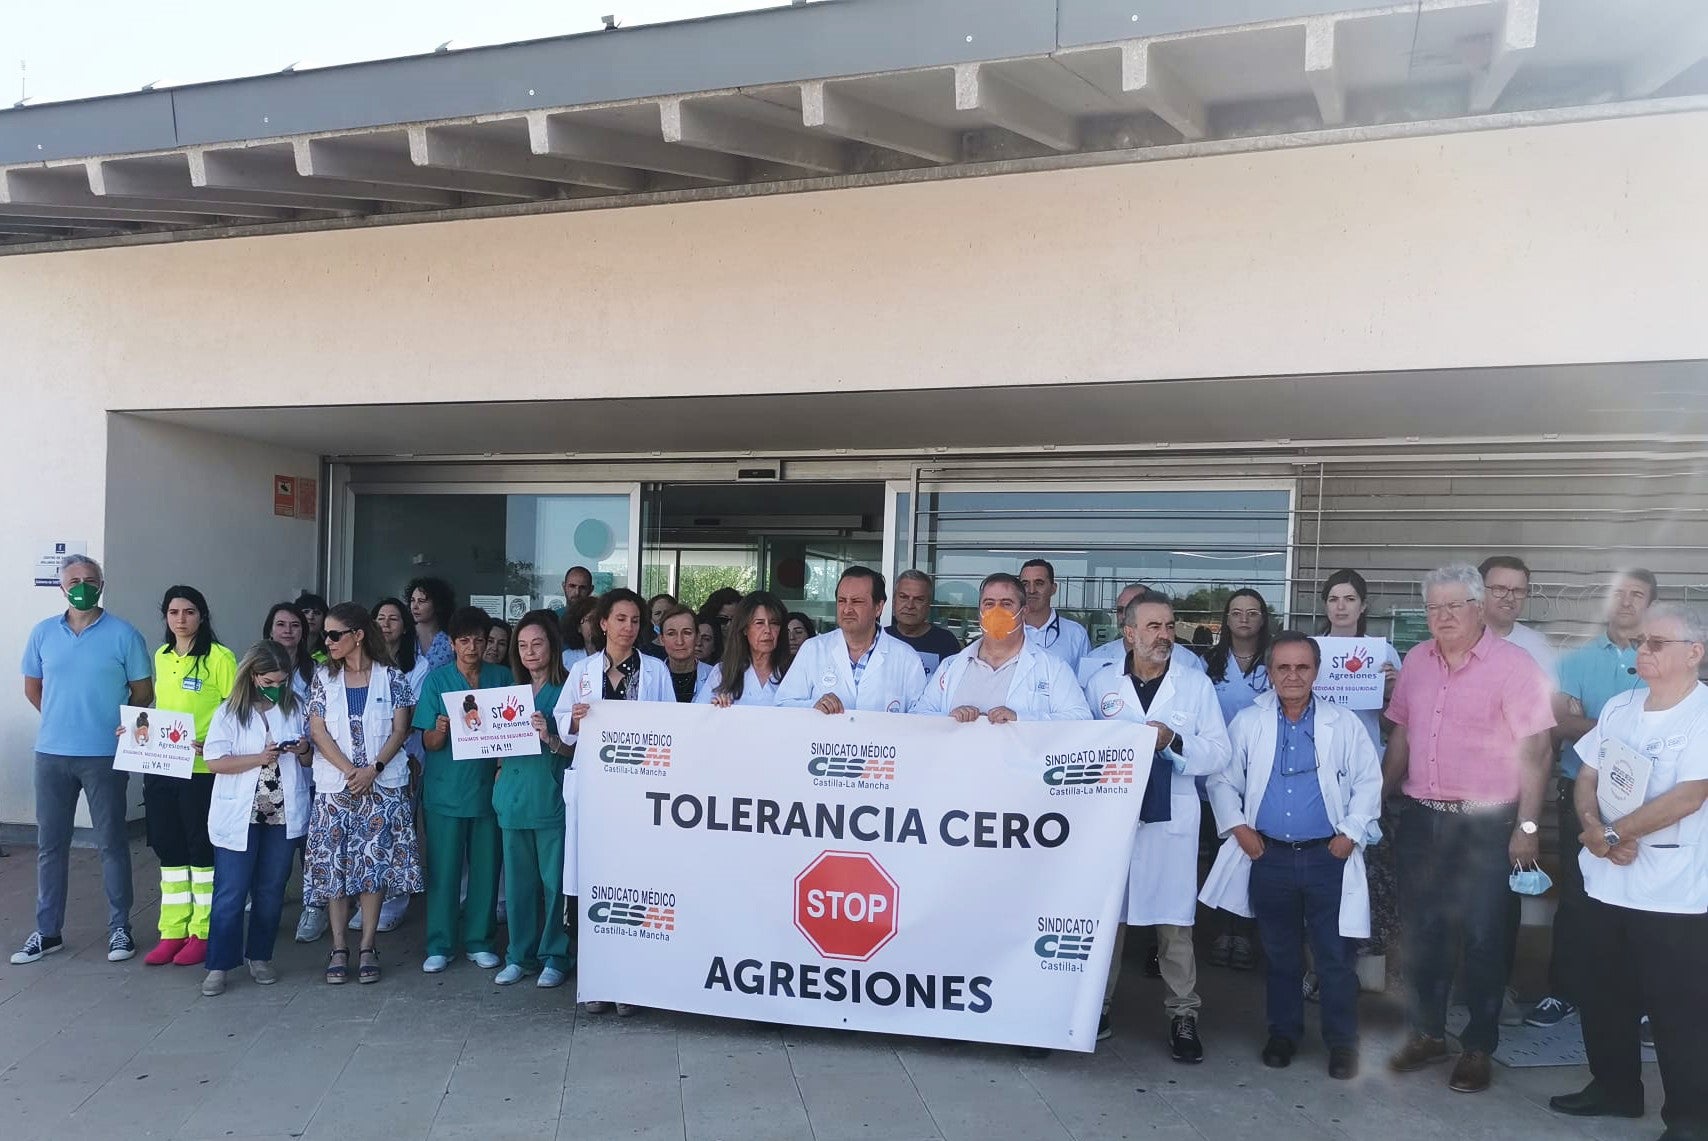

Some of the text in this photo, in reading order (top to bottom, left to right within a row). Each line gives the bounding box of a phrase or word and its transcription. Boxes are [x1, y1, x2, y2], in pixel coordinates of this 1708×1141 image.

[1329, 672, 1377, 680] Agresiones
[492, 720, 530, 730] Agresiones
[159, 742, 191, 751] Agresiones
[601, 730, 672, 747] SINDICATO MÉDICO
[490, 744, 502, 752] YA
[599, 744, 671, 768] CESM
[811, 741, 896, 759] SINDICATO MÉDICO
[1045, 746, 1135, 767] SINDICATO MÉDICO
[151, 760, 162, 769] YA
[603, 764, 667, 777] Castilla-La Mancha
[807, 756, 895, 780] CESM
[813, 777, 890, 790] Castilla-La Mancha
[1042, 763, 1134, 786] CESM
[1049, 786, 1128, 796] Castilla-La Mancha
[645, 791, 1070, 849] TOLERANCIA CERO
[591, 885, 676, 907] SINDICATO MÉDICO
[806, 888, 888, 923] STOP
[587, 901, 675, 931] CESM
[593, 924, 670, 942] Castilla-La Mancha
[1037, 916, 1094, 935] SINDICATO
[704, 956, 993, 1014] AGRESIONES
